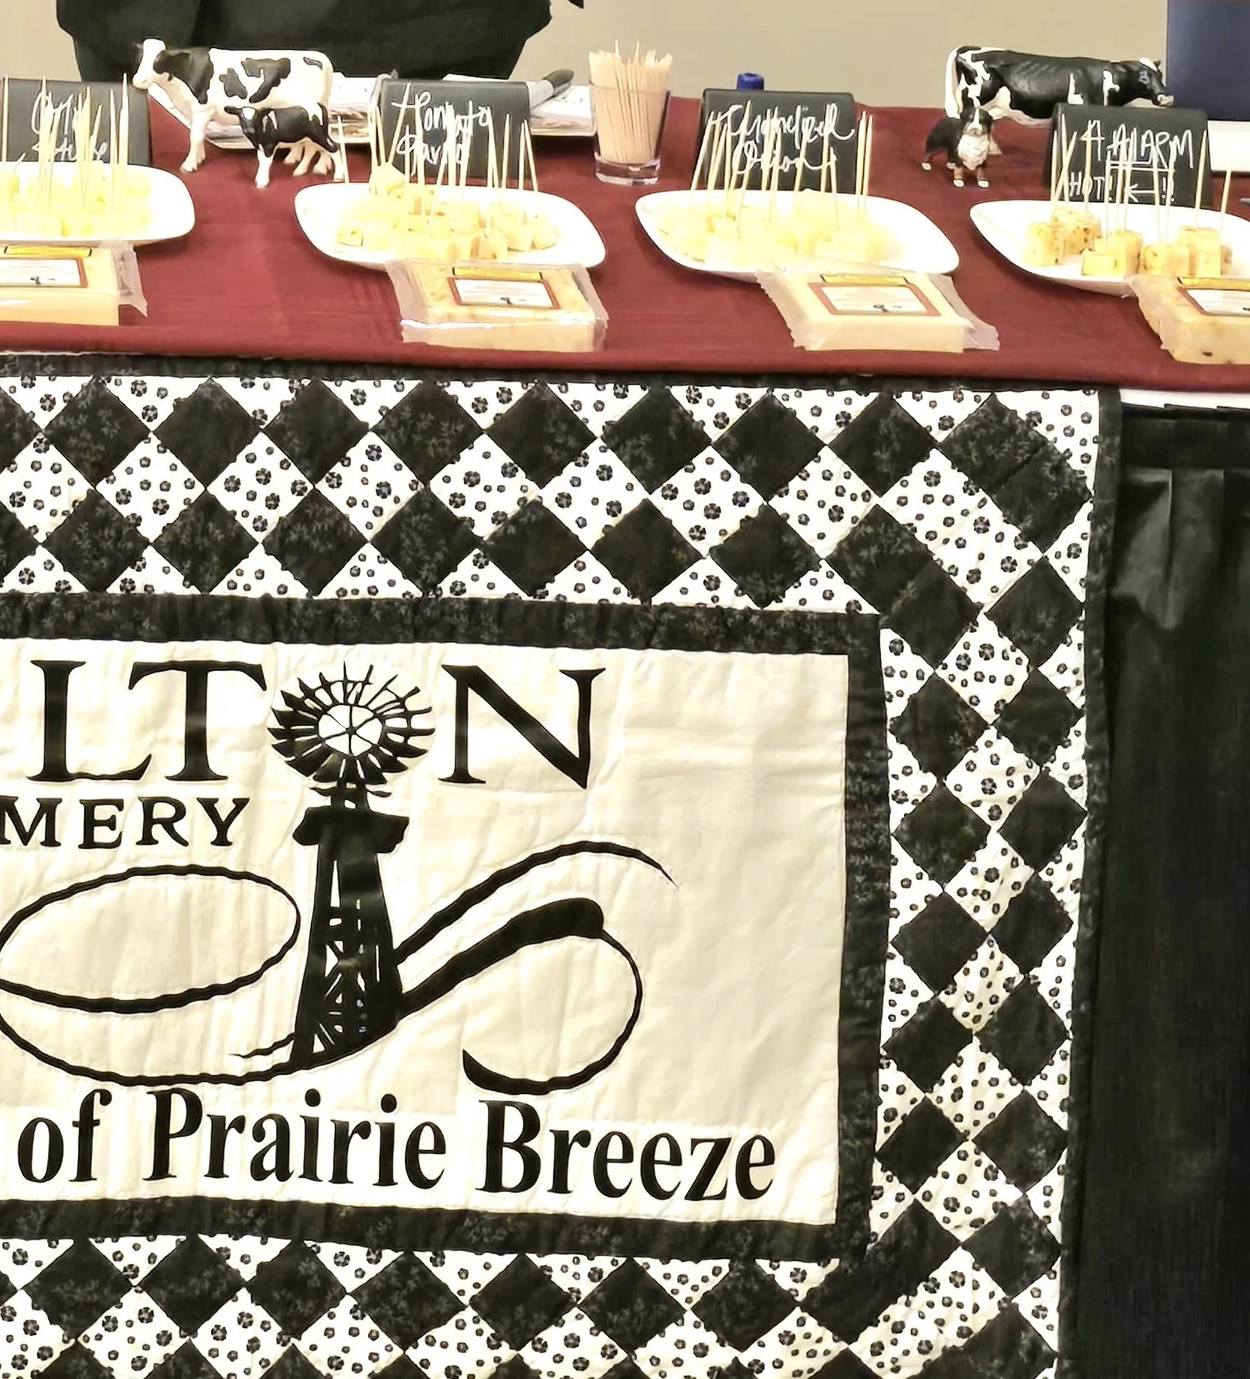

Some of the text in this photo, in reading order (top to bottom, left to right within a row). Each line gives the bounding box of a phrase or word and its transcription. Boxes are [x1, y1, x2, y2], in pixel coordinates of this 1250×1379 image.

[391, 92, 491, 139] Tomto
[17, 1088, 113, 1183] of
[142, 1087, 447, 1190] Prairie
[476, 1099, 777, 1202] Breeze
